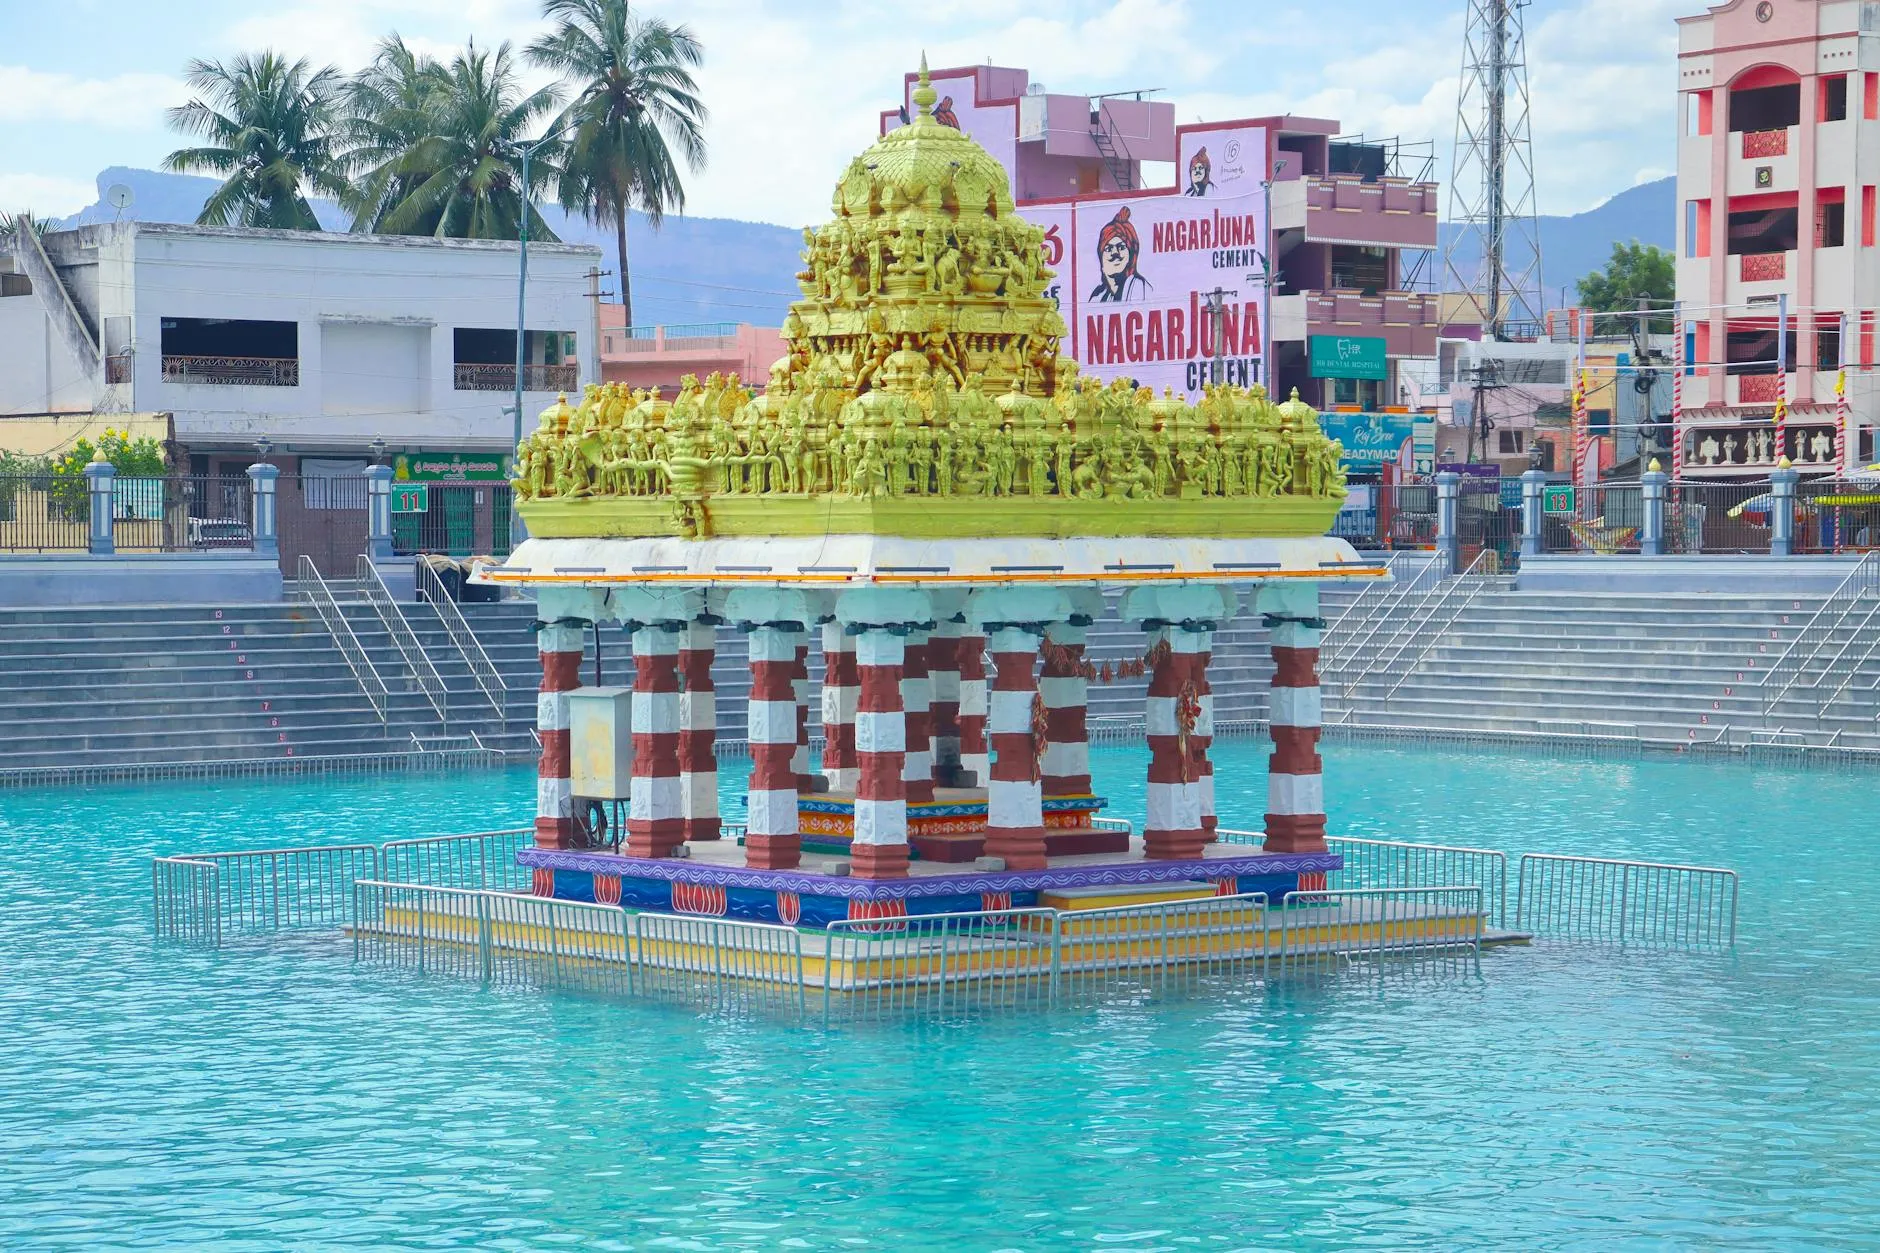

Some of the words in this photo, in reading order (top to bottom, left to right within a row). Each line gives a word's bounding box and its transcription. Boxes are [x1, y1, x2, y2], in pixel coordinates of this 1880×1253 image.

[1227, 143, 1240, 159] 16
[1152, 208, 1256, 254] NAGARJUNA
[1212, 249, 1257, 269] CEMENT
[1086, 290, 1262, 365] NAGARJUNA
[1352, 361, 1380, 369] HOSPITAL
[401, 492, 419, 510] 11
[1551, 493, 1567, 510] 13
[215, 609, 223, 619] 13
[223, 625, 231, 634] 12
